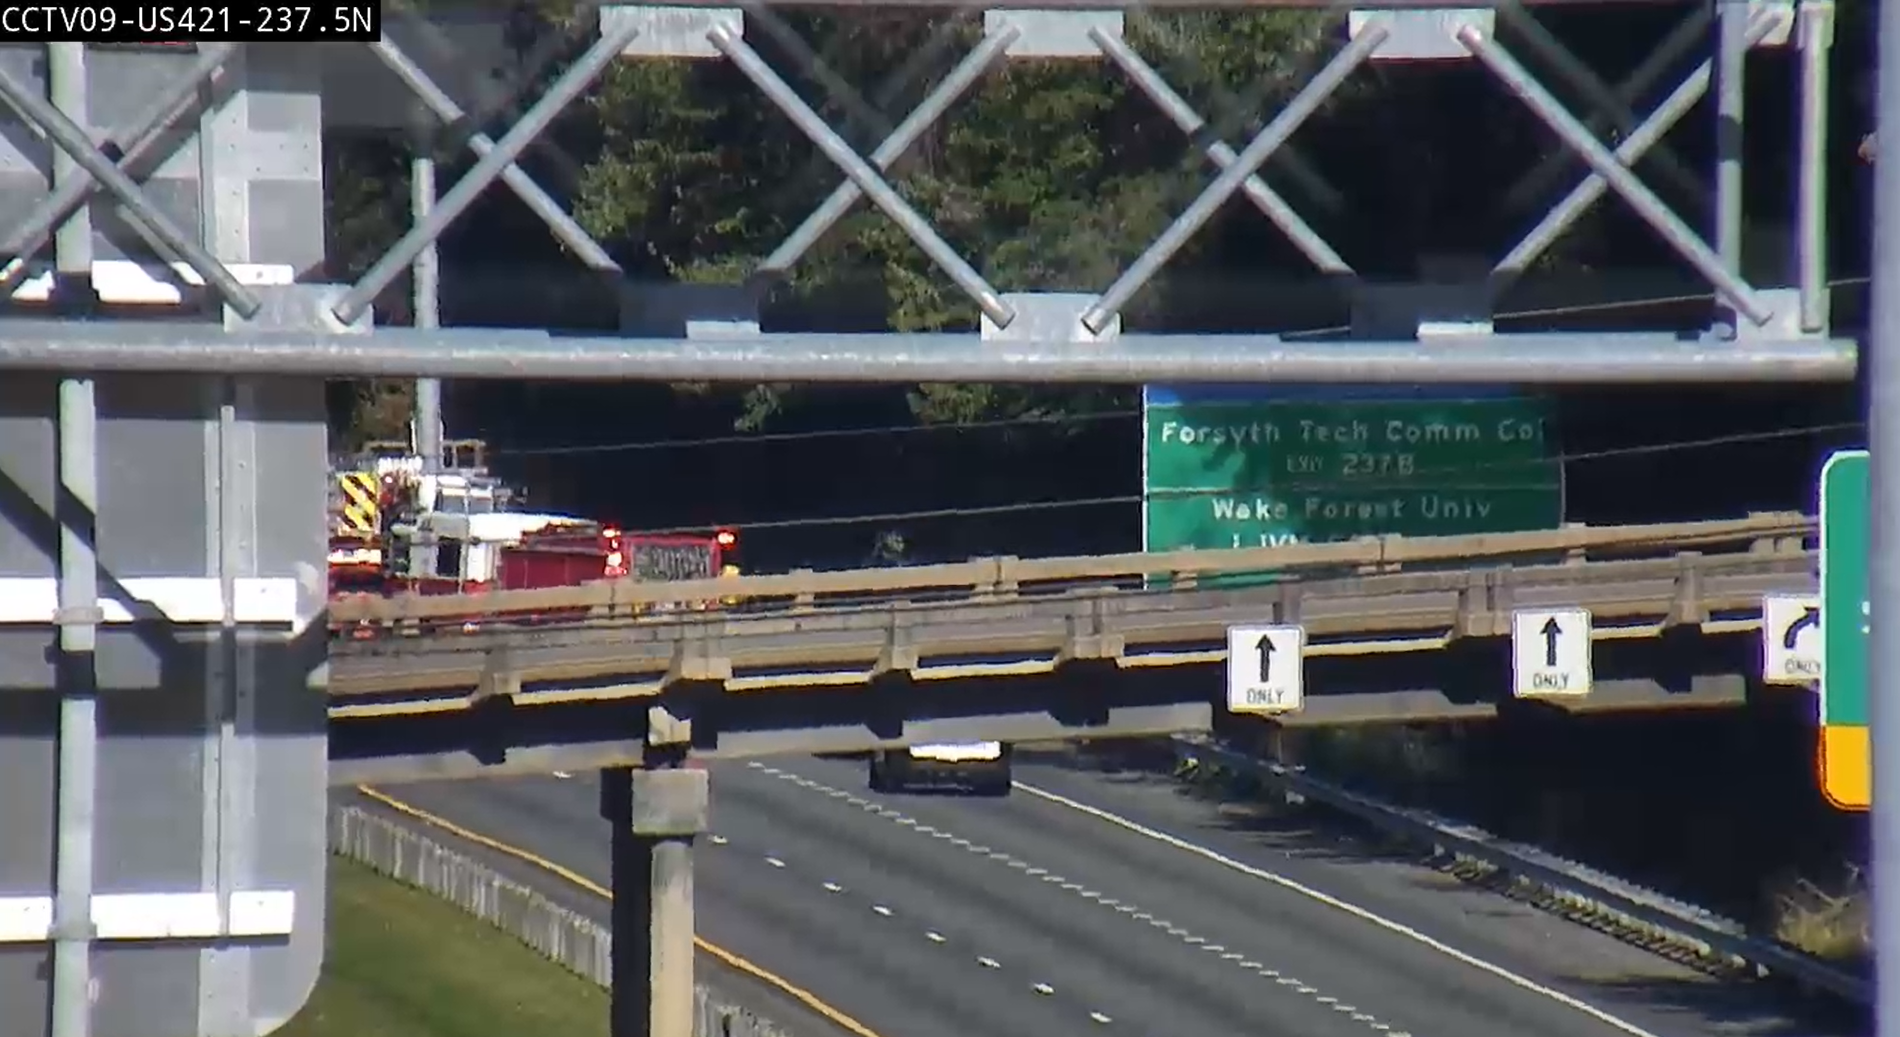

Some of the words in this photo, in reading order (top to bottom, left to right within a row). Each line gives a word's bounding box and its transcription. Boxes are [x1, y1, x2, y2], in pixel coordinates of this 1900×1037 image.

[1161, 420, 1281, 451] Forsyth
[1300, 419, 1368, 443] Tech
[1385, 420, 1480, 443] Comm
[1341, 453, 1415, 476] 237B
[1211, 498, 1288, 520] Wake
[1304, 498, 1404, 519] Forest
[1421, 496, 1491, 519] Univ
[1533, 672, 1569, 691] ONLY
[1246, 687, 1285, 704] ONLY
